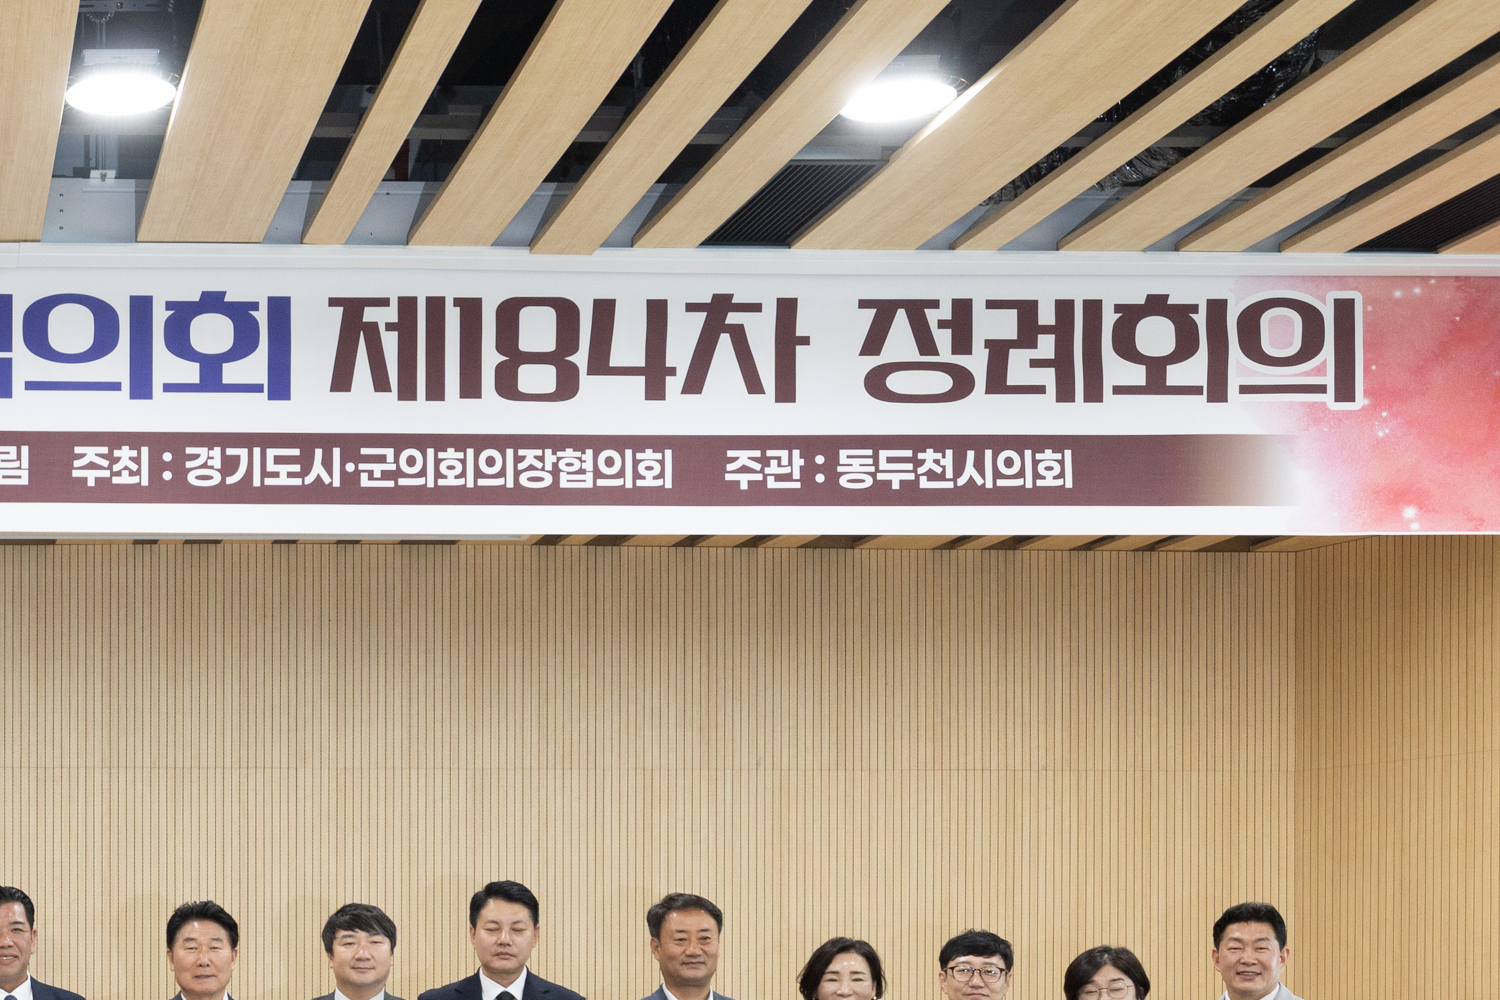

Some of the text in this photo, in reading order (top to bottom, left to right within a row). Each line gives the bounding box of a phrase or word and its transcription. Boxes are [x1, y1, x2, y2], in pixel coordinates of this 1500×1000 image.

[328, 293, 811, 403] 제184차
[857, 293, 1357, 404] 정례회의
[71, 445, 149, 487] 주최
[185, 446, 673, 489] 경기도시·군의회의장협의회
[724, 449, 805, 490] 주관
[836, 448, 1073, 490] 동두천시의회
